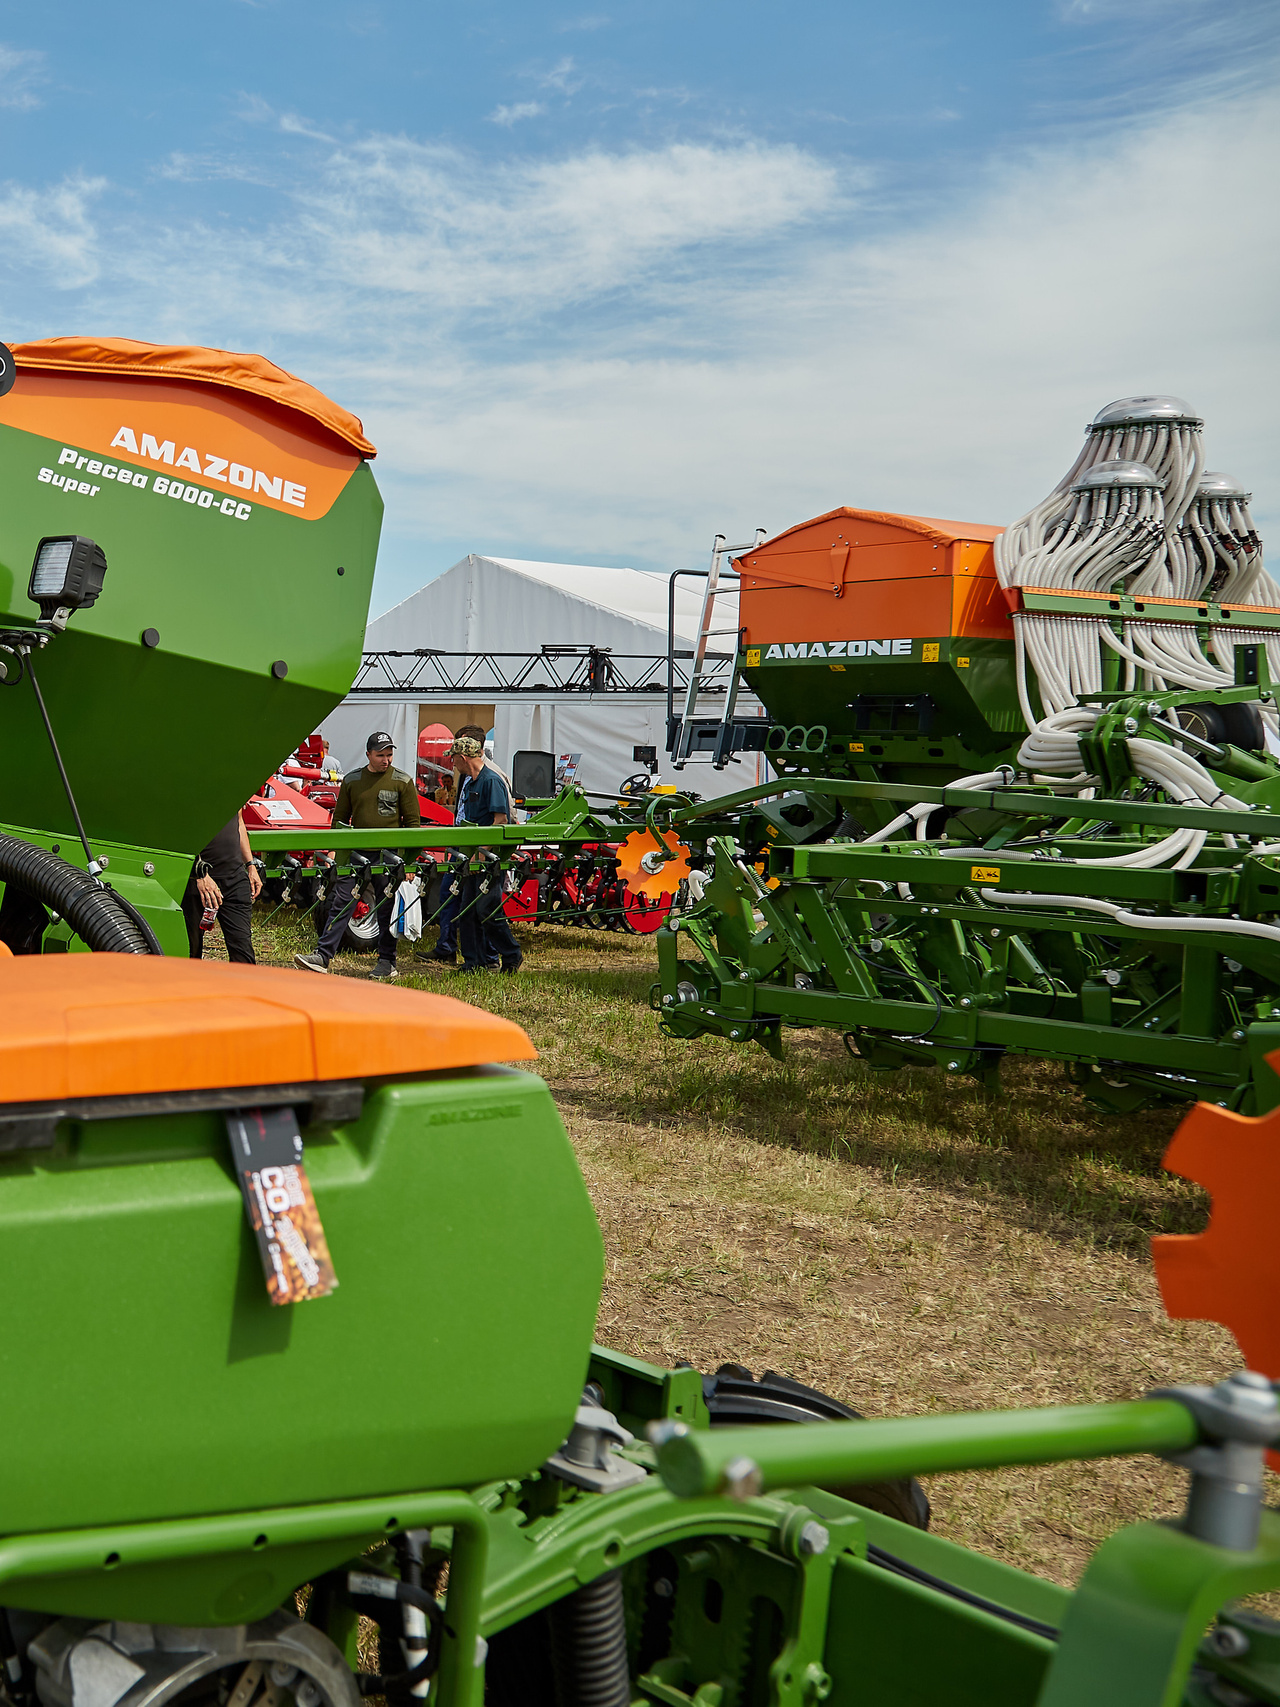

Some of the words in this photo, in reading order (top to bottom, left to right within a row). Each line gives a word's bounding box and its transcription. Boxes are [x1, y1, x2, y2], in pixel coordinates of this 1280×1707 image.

[37, 466, 101, 497] Super
[57, 446, 149, 489] Precea
[152, 476, 252, 521] 6000-CC
[110, 425, 307, 508] AMAZONE
[764, 638, 913, 660] AMAZONE
